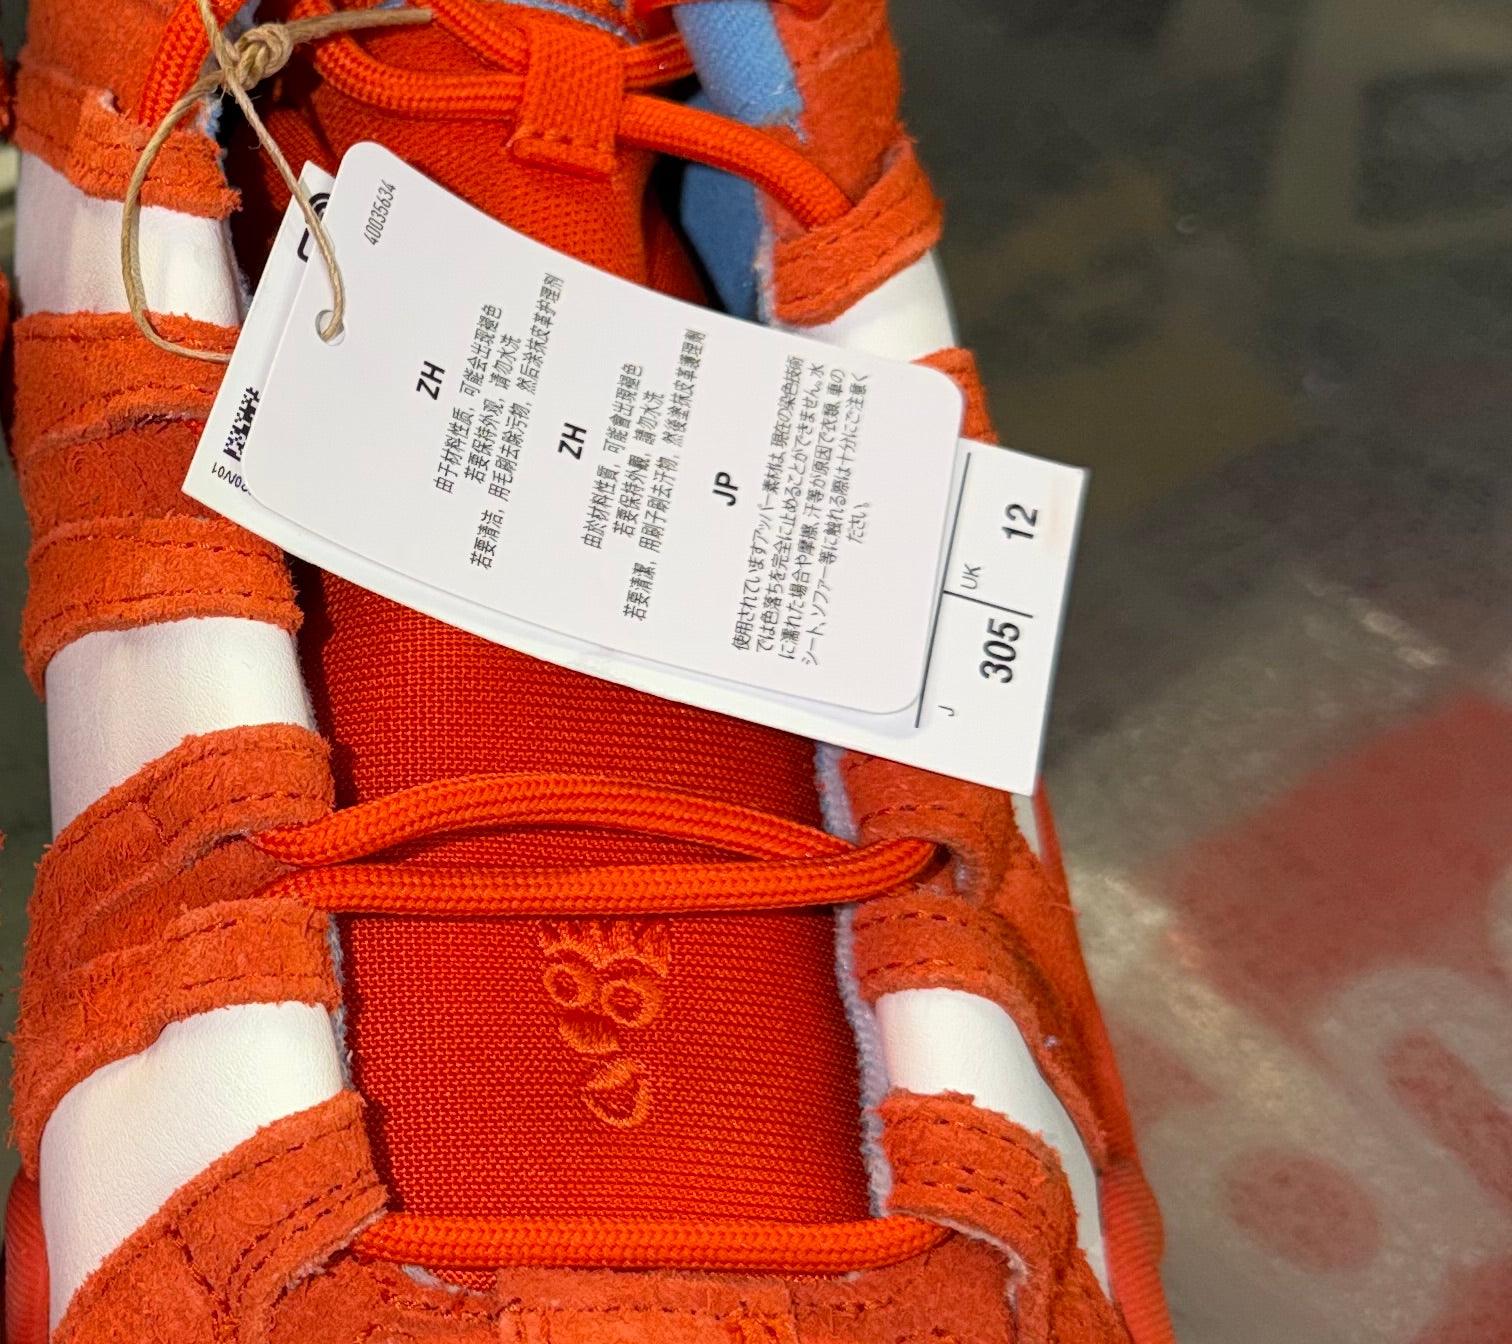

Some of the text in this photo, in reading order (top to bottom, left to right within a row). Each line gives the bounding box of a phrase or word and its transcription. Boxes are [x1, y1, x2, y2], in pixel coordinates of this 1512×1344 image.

[363, 179, 397, 246] 40035634
[415, 360, 446, 401] ZH
[557, 421, 588, 461] ZH
[711, 471, 740, 507] JP
[1001, 503, 1039, 540] 12
[960, 563, 982, 590] UK
[978, 617, 1021, 684] 305
